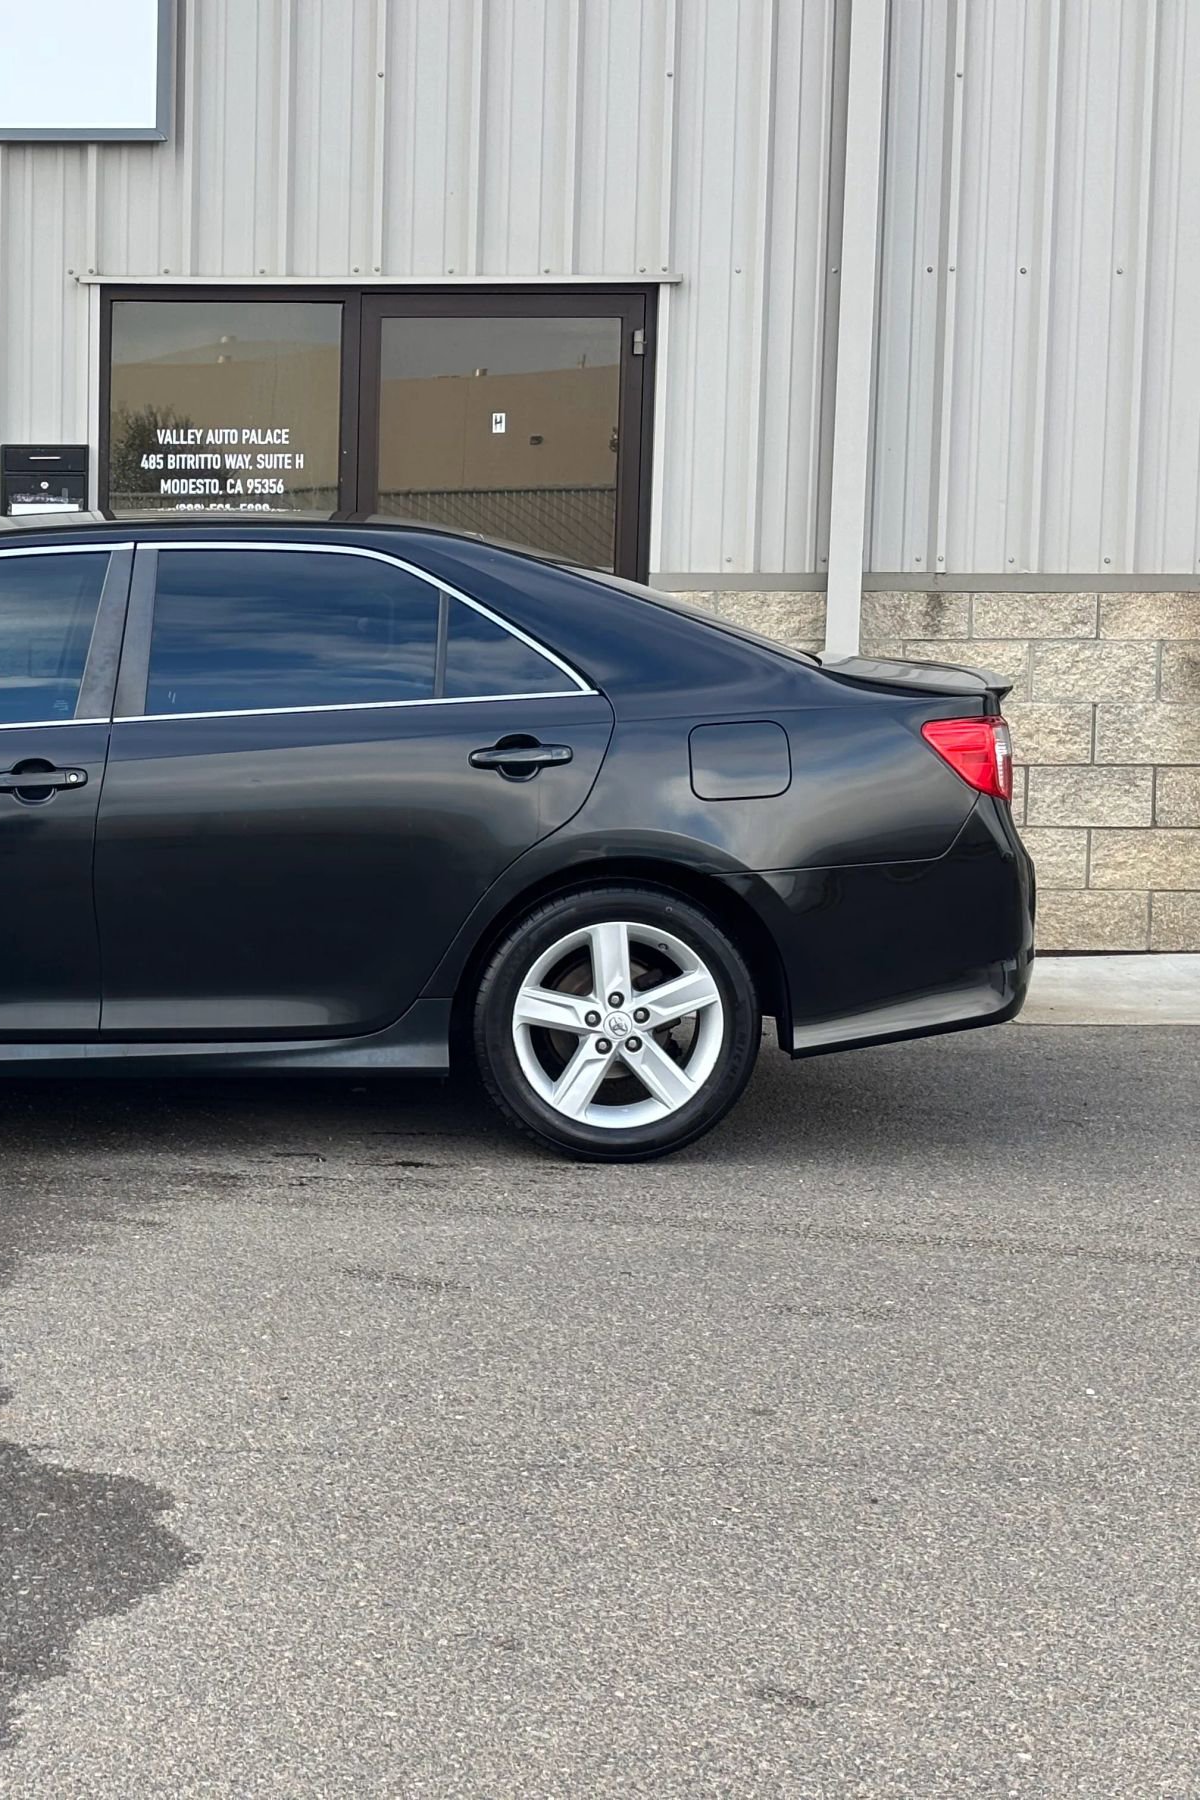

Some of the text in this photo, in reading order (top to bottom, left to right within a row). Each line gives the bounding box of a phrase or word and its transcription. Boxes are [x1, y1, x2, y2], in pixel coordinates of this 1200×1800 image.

[156, 429, 290, 445] VALLEY AUTO PALACE
[140, 454, 304, 470] 485 BITRITTO WAY, SUITE H
[160, 479, 284, 495] MODESTO, CA 95356
